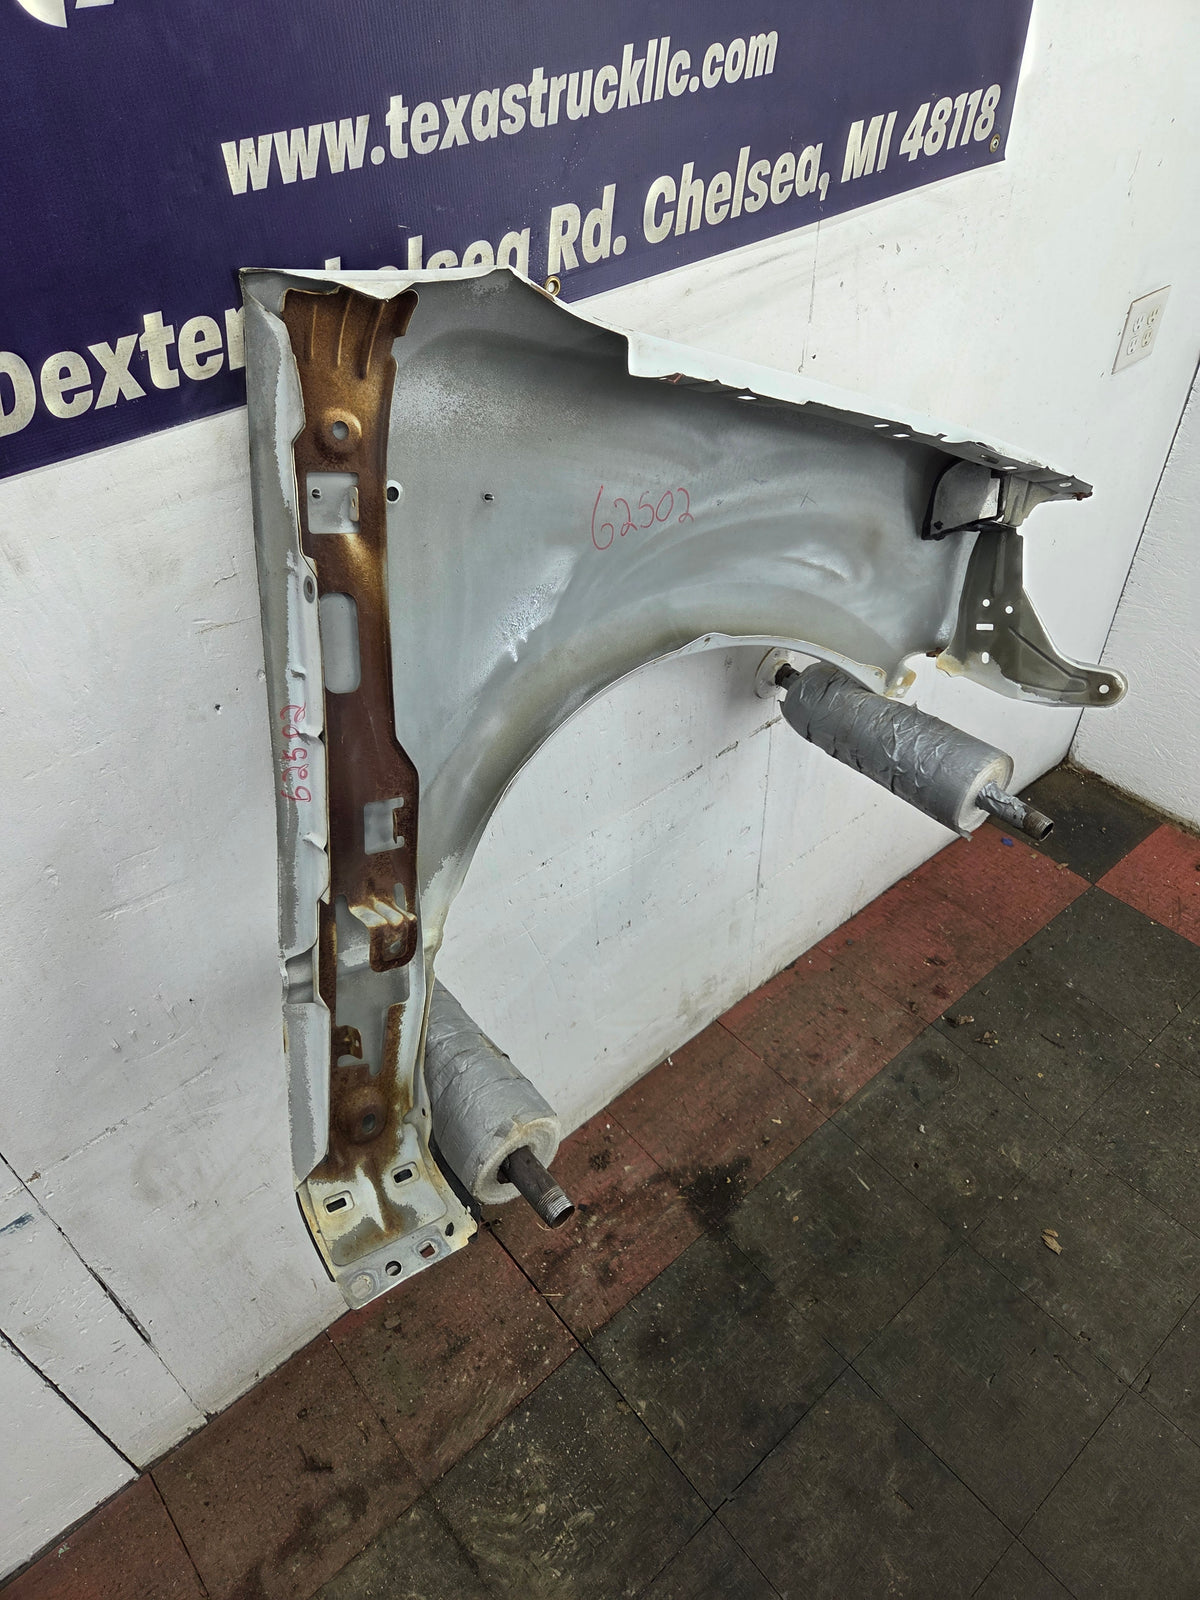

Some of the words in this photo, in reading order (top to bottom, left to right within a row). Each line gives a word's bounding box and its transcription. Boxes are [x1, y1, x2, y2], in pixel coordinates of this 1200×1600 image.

[220, 30, 779, 196] www.texastruckllc.com
[547, 184, 627, 277] Rd.
[643, 145, 830, 244] Chelsea,
[840, 110, 898, 184] MI
[898, 83, 1001, 162] 48118
[591, 485, 694, 550] 62502
